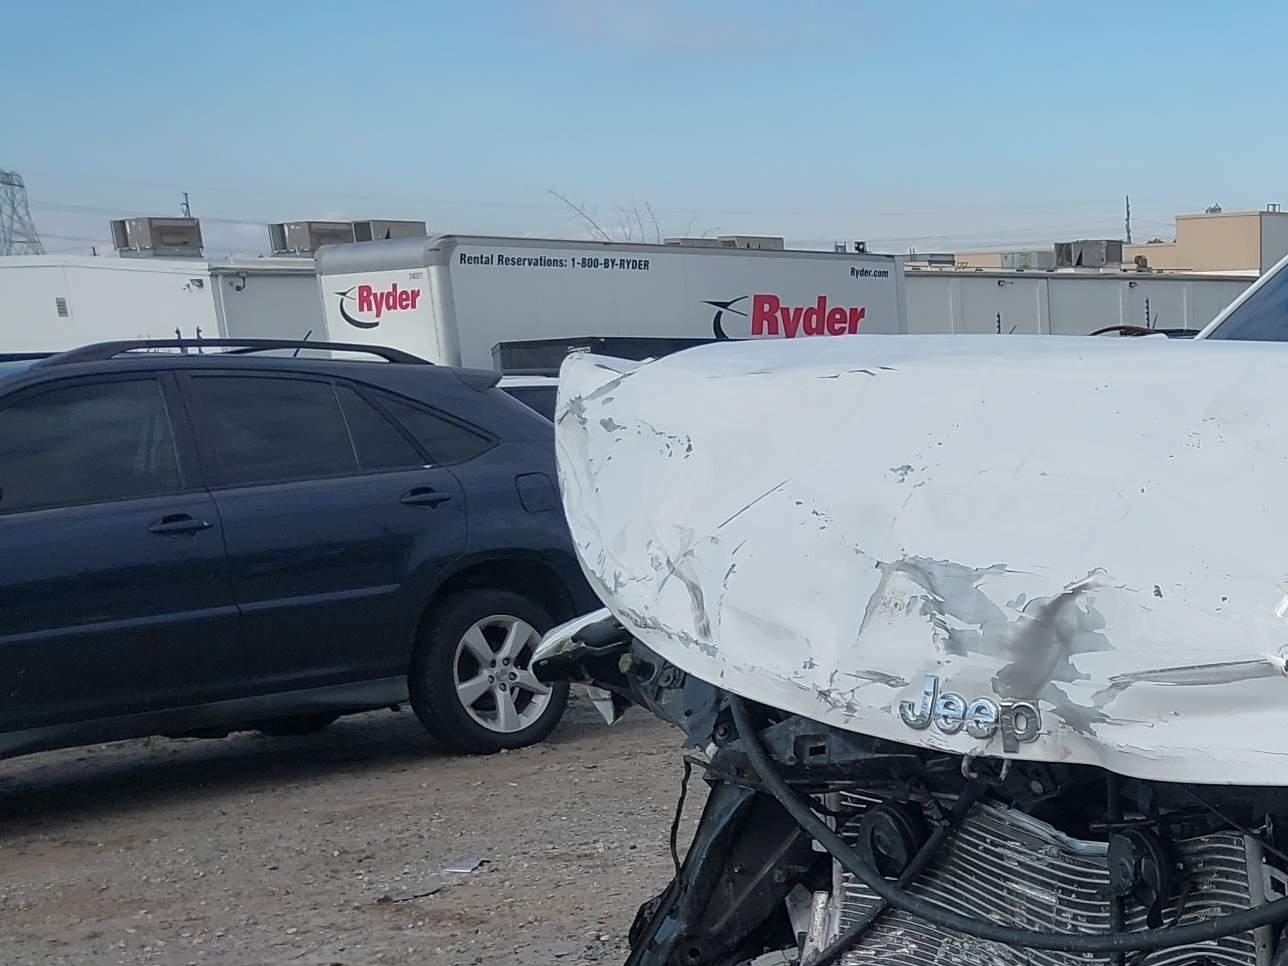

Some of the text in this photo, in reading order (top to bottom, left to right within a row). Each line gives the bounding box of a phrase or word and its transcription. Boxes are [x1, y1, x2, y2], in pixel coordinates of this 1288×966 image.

[459, 253, 650, 270] Rental Reservations: 1-800-BY-RYDER
[850, 267, 889, 279] Ryder.com
[357, 283, 421, 318] Ryder
[751, 294, 866, 339] Ryder
[898, 674, 1043, 753] Jeep
